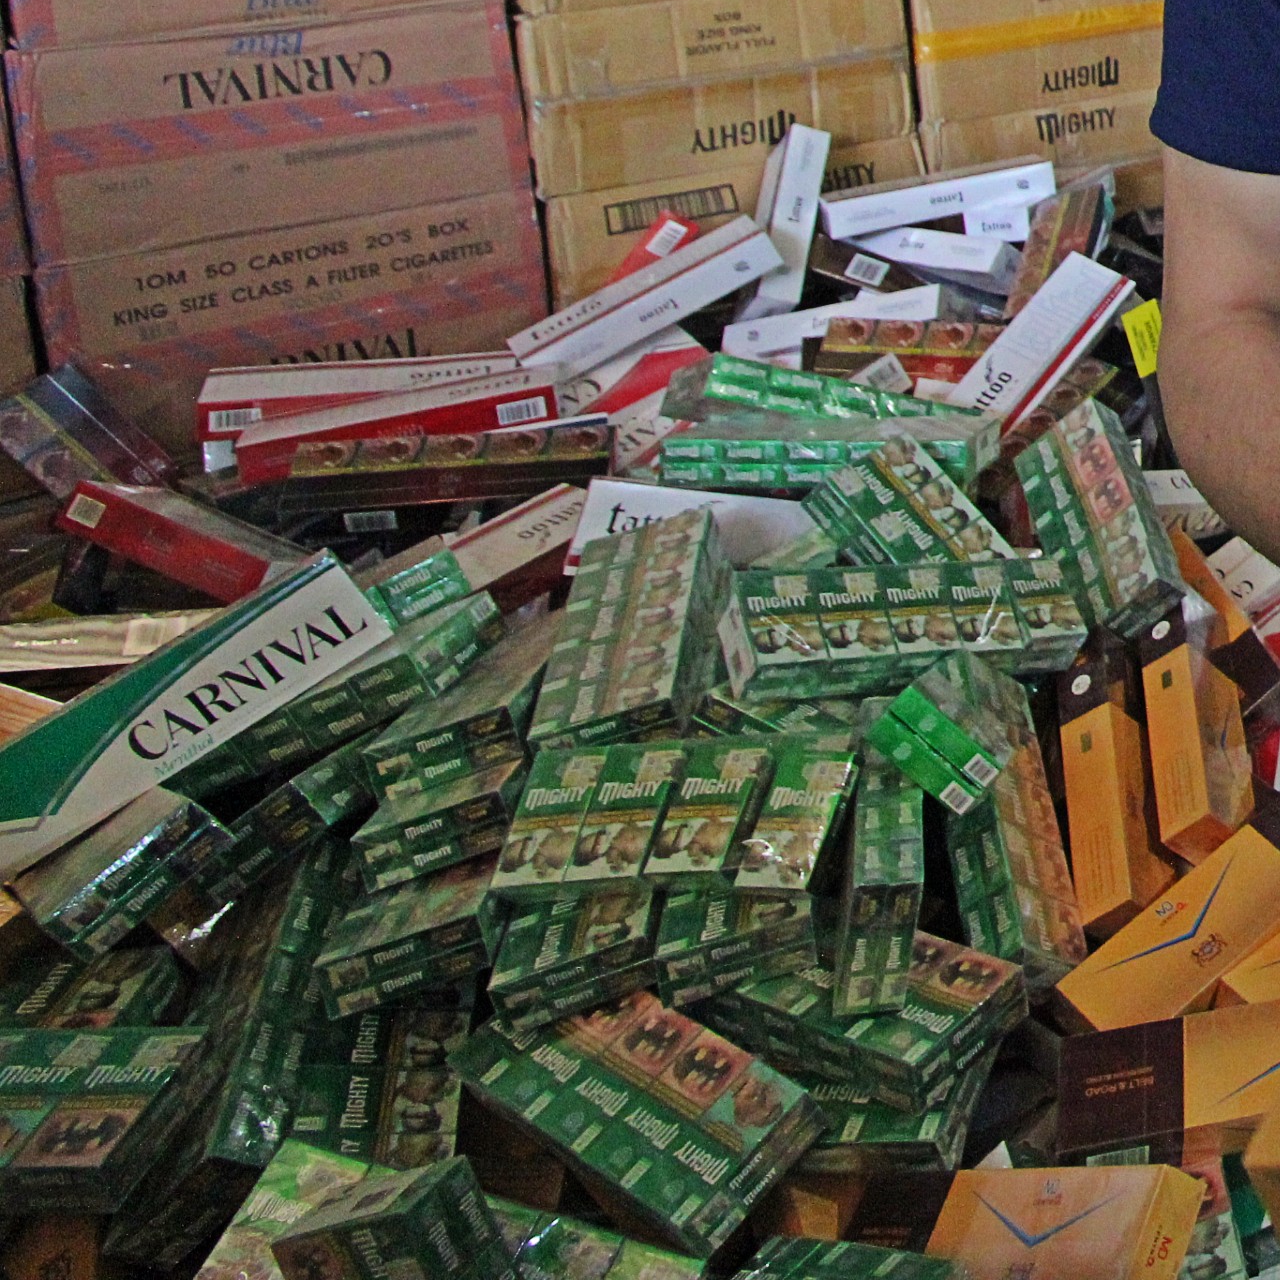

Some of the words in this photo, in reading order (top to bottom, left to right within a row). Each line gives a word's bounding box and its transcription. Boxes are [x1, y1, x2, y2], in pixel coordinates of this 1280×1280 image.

[163, 48, 391, 109] CARNIVAL
[1041, 57, 1120, 93] MIGHTY
[691, 108, 796, 155] MIGHTY
[1035, 107, 1116, 145] MIGHTY
[248, 240, 348, 272] CARTONS
[427, 218, 470, 240] BOX
[113, 303, 168, 327] KING
[181, 292, 219, 312] SIZE
[232, 278, 294, 304] CLASS
[305, 275, 319, 290] A
[328, 264, 380, 286] FILTER
[391, 240, 494, 272] CIGARETTES
[886, 585, 942, 604] MIGHTY
[951, 584, 1002, 603] MIGHTY
[1012, 577, 1062, 594] MIGHTY
[747, 594, 807, 614] MIGHTY
[818, 590, 877, 609] MIGHTY
[127, 605, 368, 761] CARNIVAL
[415, 732, 454, 753] MIGHTY
[424, 757, 463, 779] MIGHTY
[526, 786, 587, 811] MIGHTY
[598, 779, 663, 805] MIGHTY
[680, 776, 745, 801] MIGHTY
[769, 786, 832, 811] MIGHTY
[404, 818, 443, 839] MIGHTY
[413, 845, 451, 868] MIGHTY
[372, 943, 416, 967] MIGHTY
[381, 969, 424, 995] MIGHTY
[901, 1003, 954, 1034] MIGHTY
[530, 1042, 582, 1084] MIGHTY
[84, 1064, 172, 1090] MIGHTY
[340, 1075, 370, 1129] MIGHTY
[575, 1075, 630, 1118] MIGHTY
[623, 1106, 681, 1151] MIGHTY
[672, 1139, 731, 1186] MIGHTY
